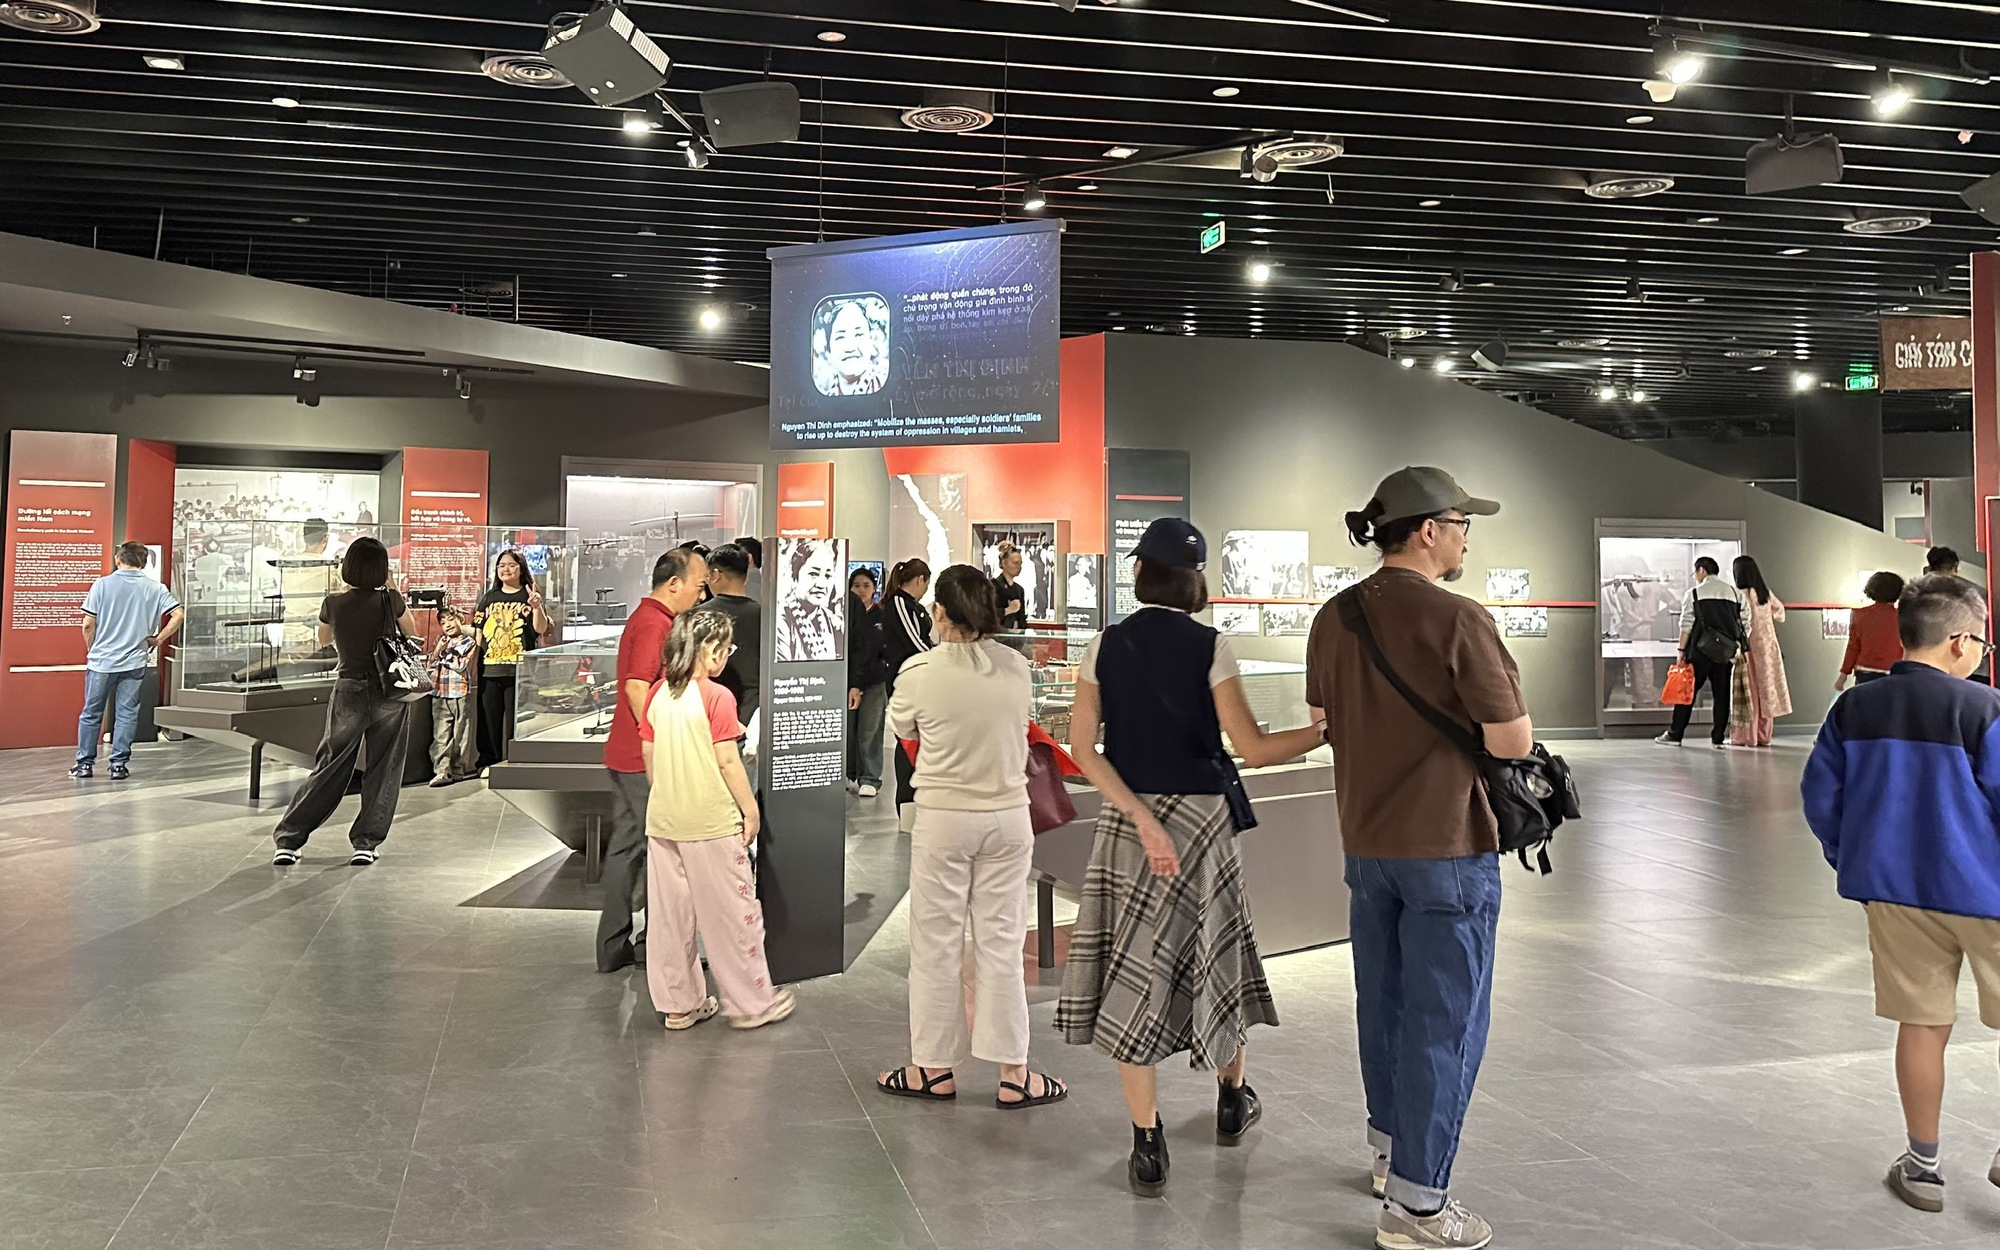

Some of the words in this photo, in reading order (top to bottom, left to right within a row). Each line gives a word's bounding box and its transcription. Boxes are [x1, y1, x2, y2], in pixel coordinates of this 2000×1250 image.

[999, 285, 1020, 294] trong
[1022, 283, 1033, 292] đó
[954, 300, 973, 309] động
[1895, 335, 1922, 368] GIẢI
[1926, 333, 1957, 368] TÁN
[782, 424, 805, 432] Nguyen
[806, 422, 816, 430] Thi
[818, 421, 832, 429] Dinh
[833, 420, 873, 430] emphasized:
[905, 417, 916, 425] the
[917, 417, 944, 426] masses,
[946, 414, 980, 424] especially
[1012, 412, 1042, 422] families
[796, 432, 804, 440] to
[817, 432, 825, 440] up
[834, 430, 858, 439] destroy
[870, 429, 894, 438] system
[904, 426, 940, 437] oppression
[942, 426, 950, 434] in
[950, 426, 976, 435] villages
[978, 425, 992, 434] and
[992, 424, 1023, 434] hamlets,
